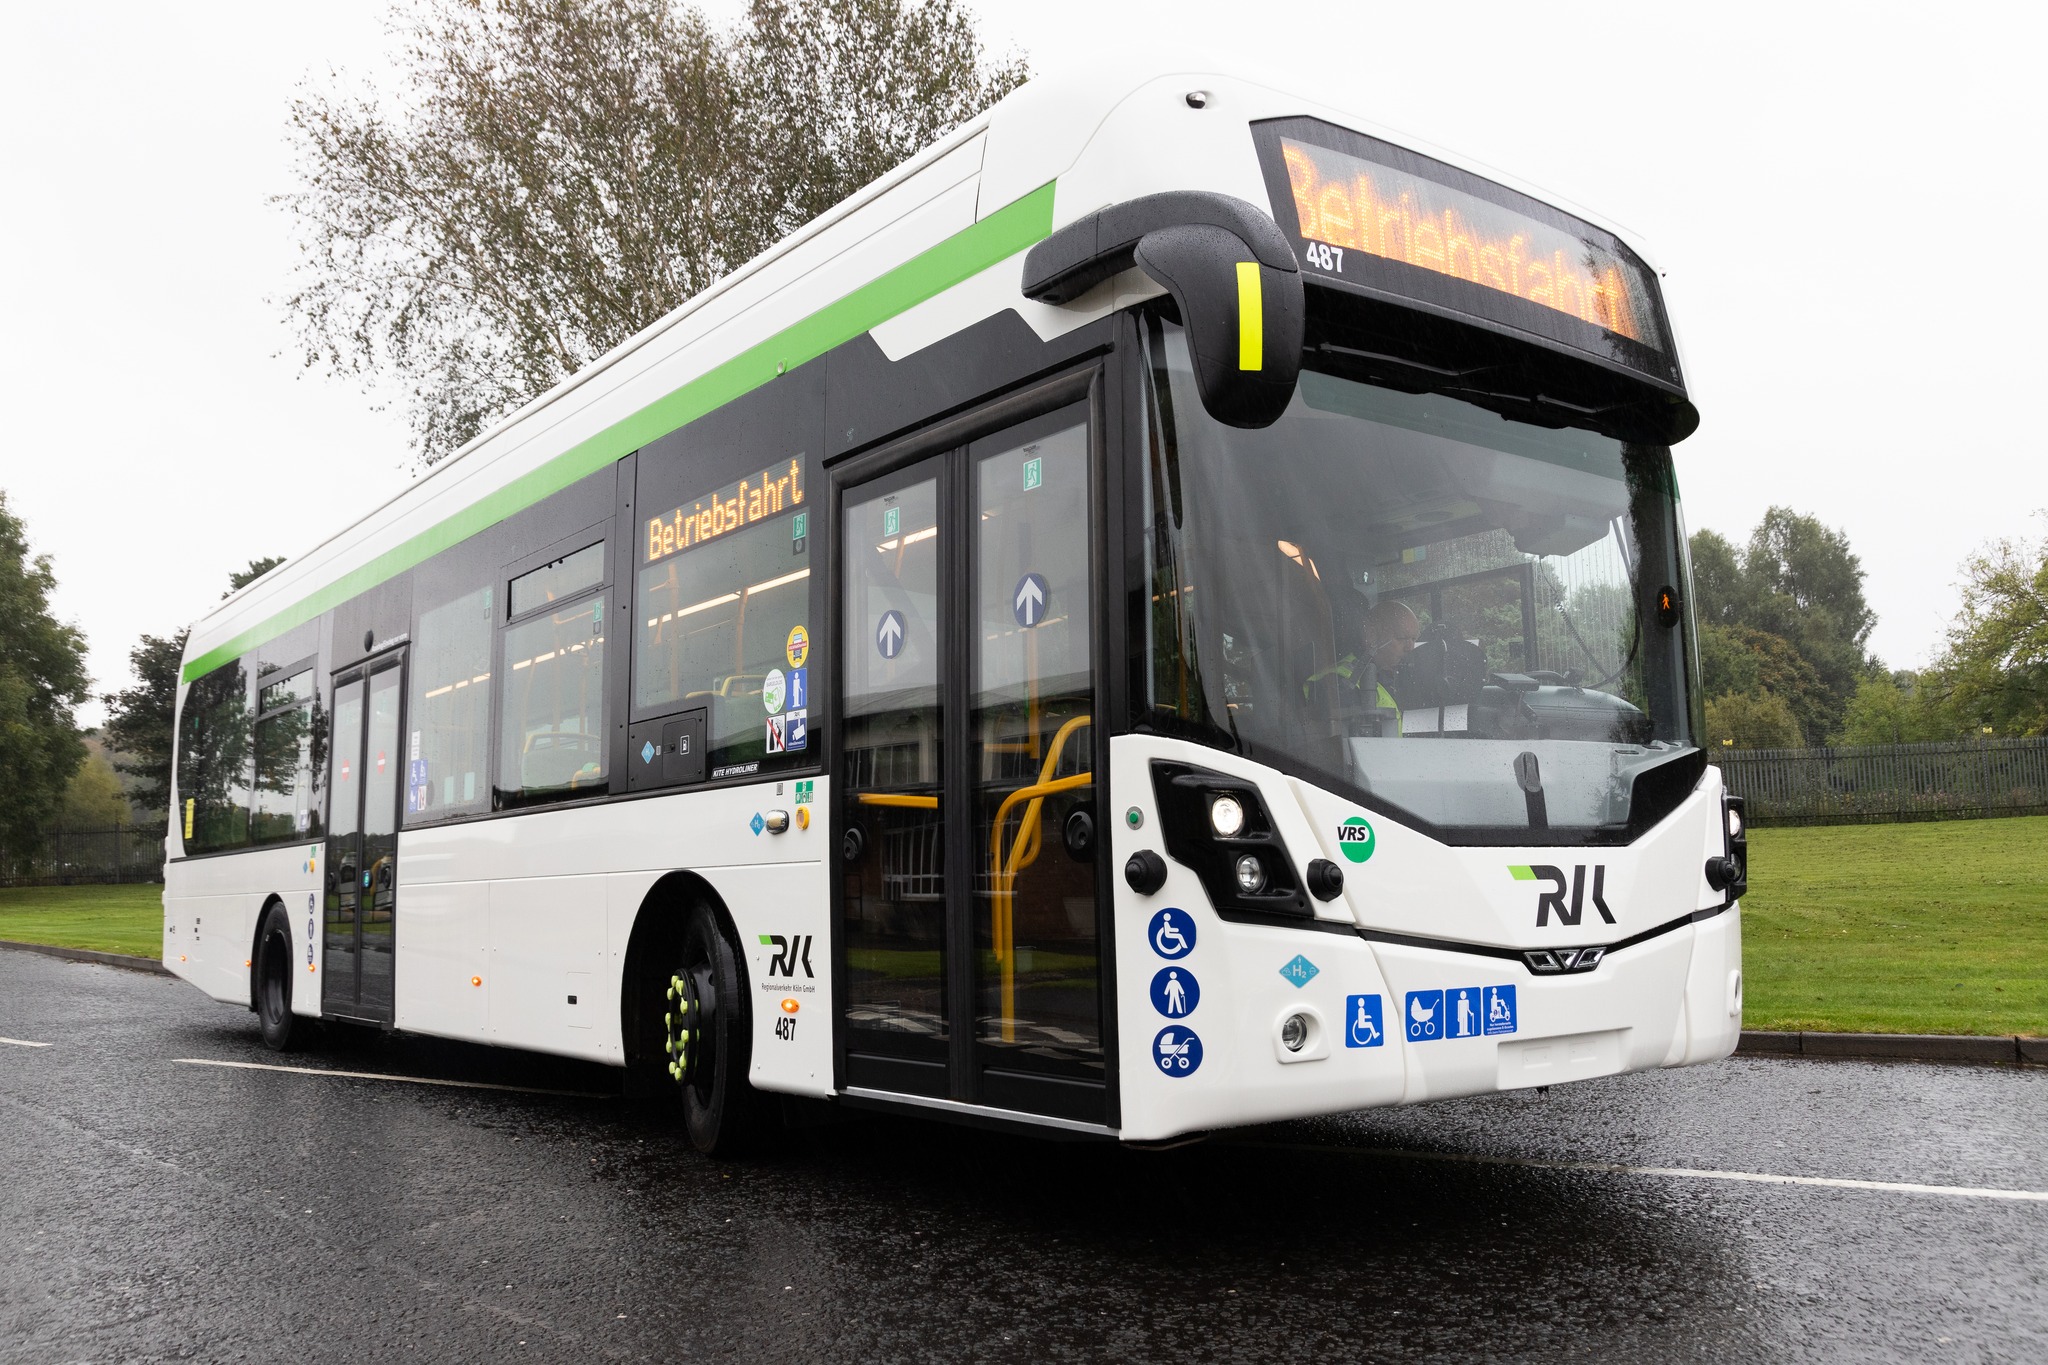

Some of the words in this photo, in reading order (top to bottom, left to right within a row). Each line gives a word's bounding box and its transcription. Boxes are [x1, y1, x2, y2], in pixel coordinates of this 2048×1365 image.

[1306, 241, 1344, 273] 487
[649, 458, 803, 561] Betriebsfahrt
[712, 769, 725, 778] KITE
[725, 763, 758, 776] HYDROLINER
[1337, 826, 1366, 841] VRS
[1508, 864, 1617, 927] RVK
[758, 934, 815, 979] RVK
[761, 983, 792, 992] Regionalverkehr
[792, 984, 803, 992] Köln
[803, 985, 816, 993] GmbH
[775, 1017, 796, 1041] 487
